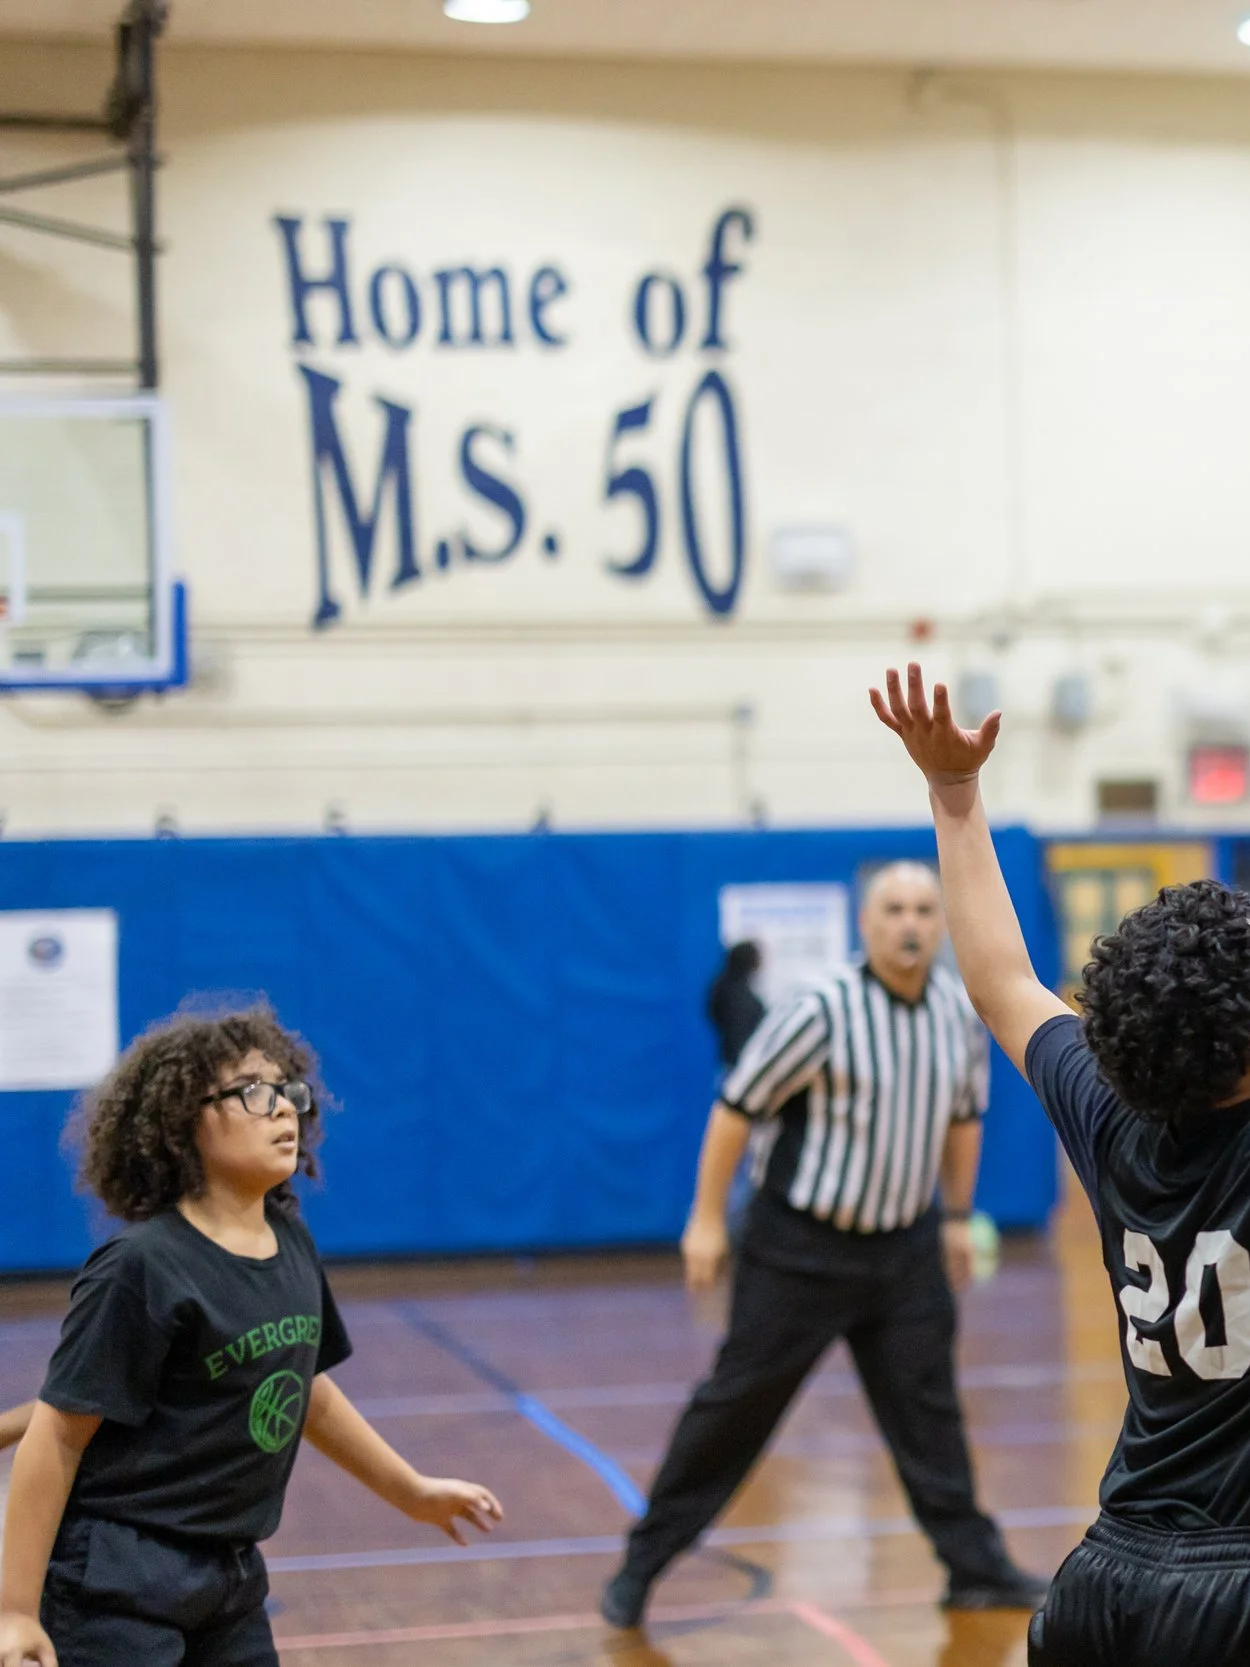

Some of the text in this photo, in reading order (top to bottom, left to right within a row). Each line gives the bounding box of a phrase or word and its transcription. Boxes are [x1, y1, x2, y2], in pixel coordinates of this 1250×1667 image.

[271, 204, 754, 357] Home of
[295, 361, 745, 631] M.S. 50
